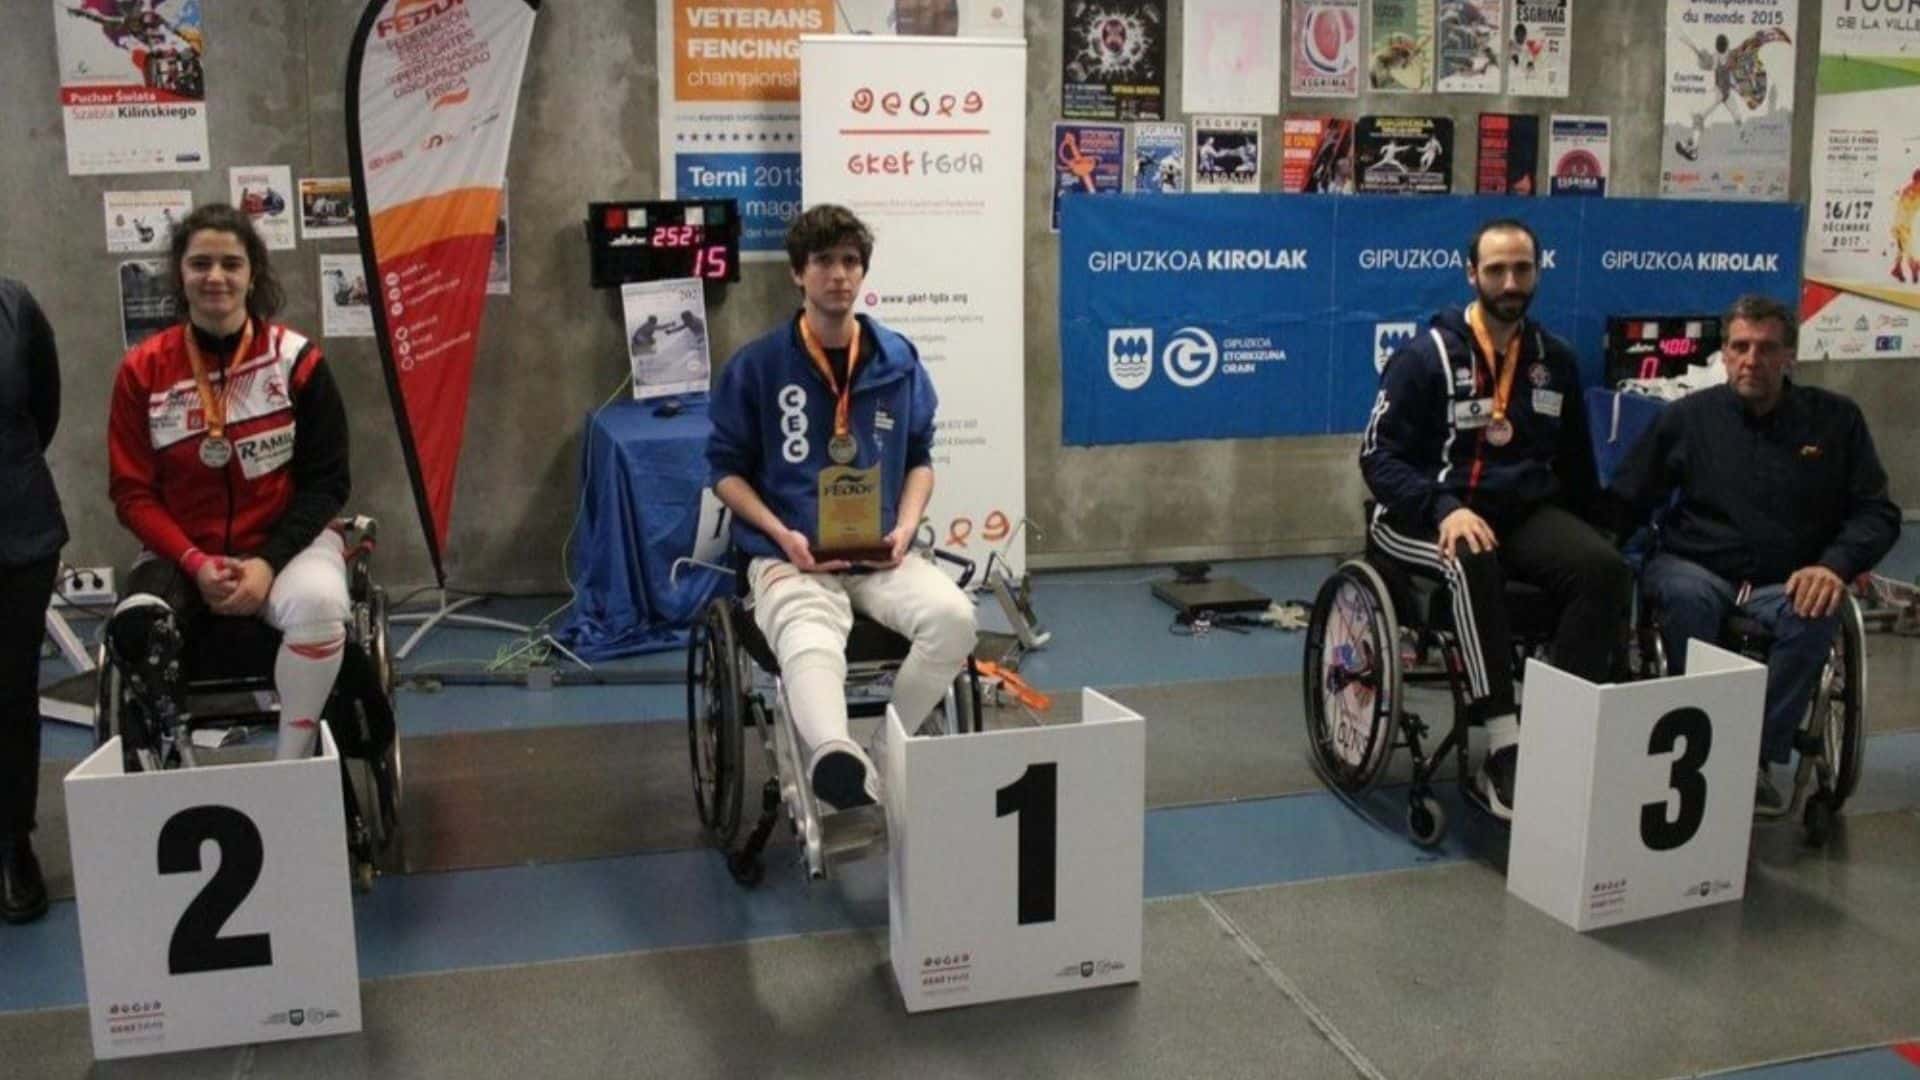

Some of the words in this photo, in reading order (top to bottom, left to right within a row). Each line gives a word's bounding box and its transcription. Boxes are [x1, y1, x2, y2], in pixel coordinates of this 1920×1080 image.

[686, 7, 823, 29] VETERANS
[1516, 6, 1565, 24] ESGRIMA
[1682, 8, 1699, 24] du
[1704, 10, 1745, 24] monde
[1751, 10, 1784, 25] 2015
[1861, 17, 1880, 29] LA
[687, 38, 800, 59] FENCING
[118, 106, 197, 119] Kilińskiego
[688, 166, 747, 187] Terni
[1825, 201, 1873, 220] 16/17
[652, 227, 693, 246] 252
[693, 247, 727, 277] 15
[1088, 250, 1201, 272] GIPUZKOA
[1207, 249, 1308, 270] KIROLAK
[1358, 249, 1463, 269] GIPUZKOA
[1601, 252, 1694, 271] GIPUZKOA
[1697, 252, 1780, 272] KIROLAK
[1222, 337, 1272, 349] GIPUZKOA
[1222, 350, 1286, 362] ETORKIZUNA
[1222, 363, 1256, 374] ORAIN
[1640, 706, 1713, 851] 3
[996, 761, 1058, 926] 1
[157, 804, 273, 976] 2
